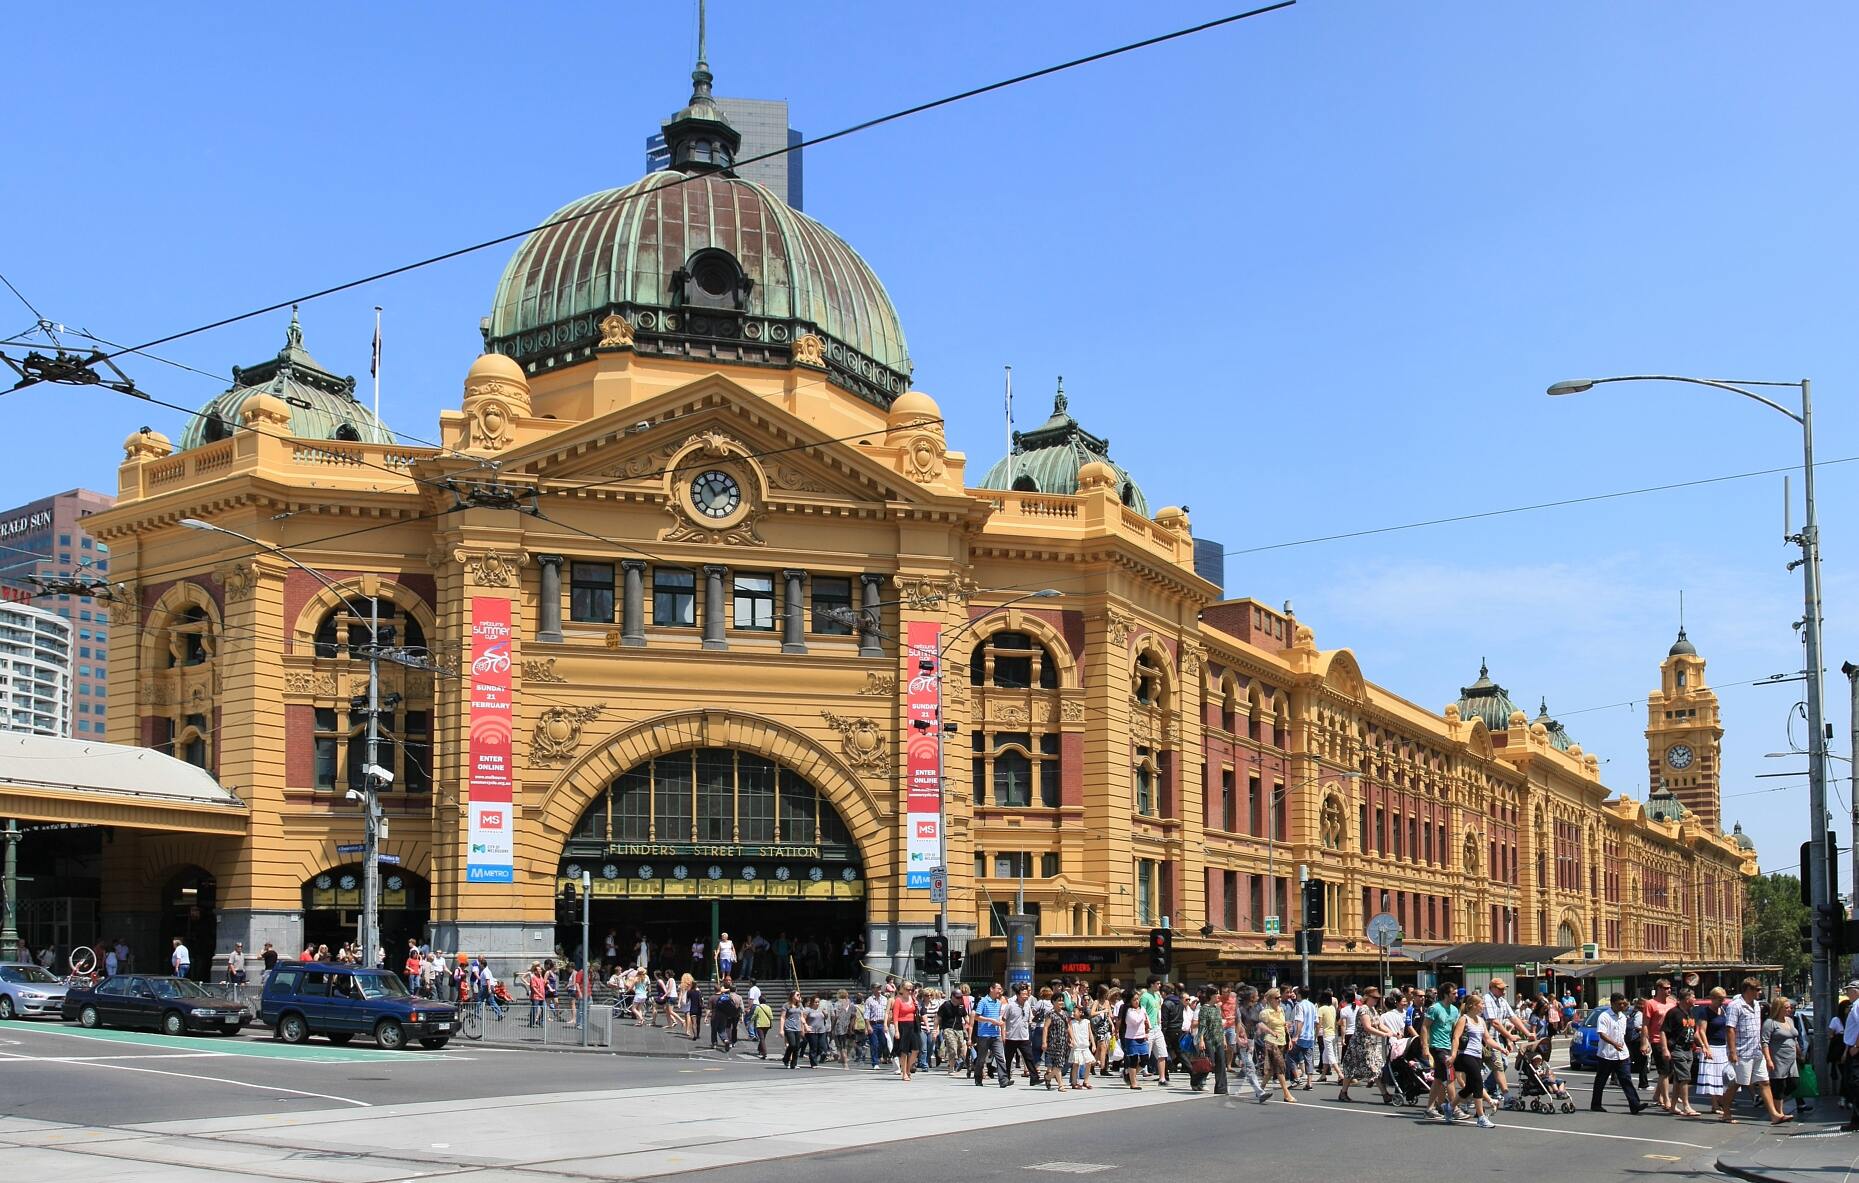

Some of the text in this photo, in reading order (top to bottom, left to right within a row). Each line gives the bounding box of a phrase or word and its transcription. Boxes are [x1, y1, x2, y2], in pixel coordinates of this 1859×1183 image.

[0, 510, 51, 536] RALD SUN
[473, 625, 510, 636] summer
[909, 649, 938, 657] summe
[476, 684, 506, 692] SUNDAY
[471, 701, 510, 709] FEBRUARY
[480, 755, 503, 763] ENTER
[477, 763, 505, 771] ONLINE
[482, 815, 500, 825] MS
[919, 825, 935, 834] MS
[609, 844, 818, 857] FLINDERS STREET STATION
[1061, 963, 1091, 973] HATTERS
